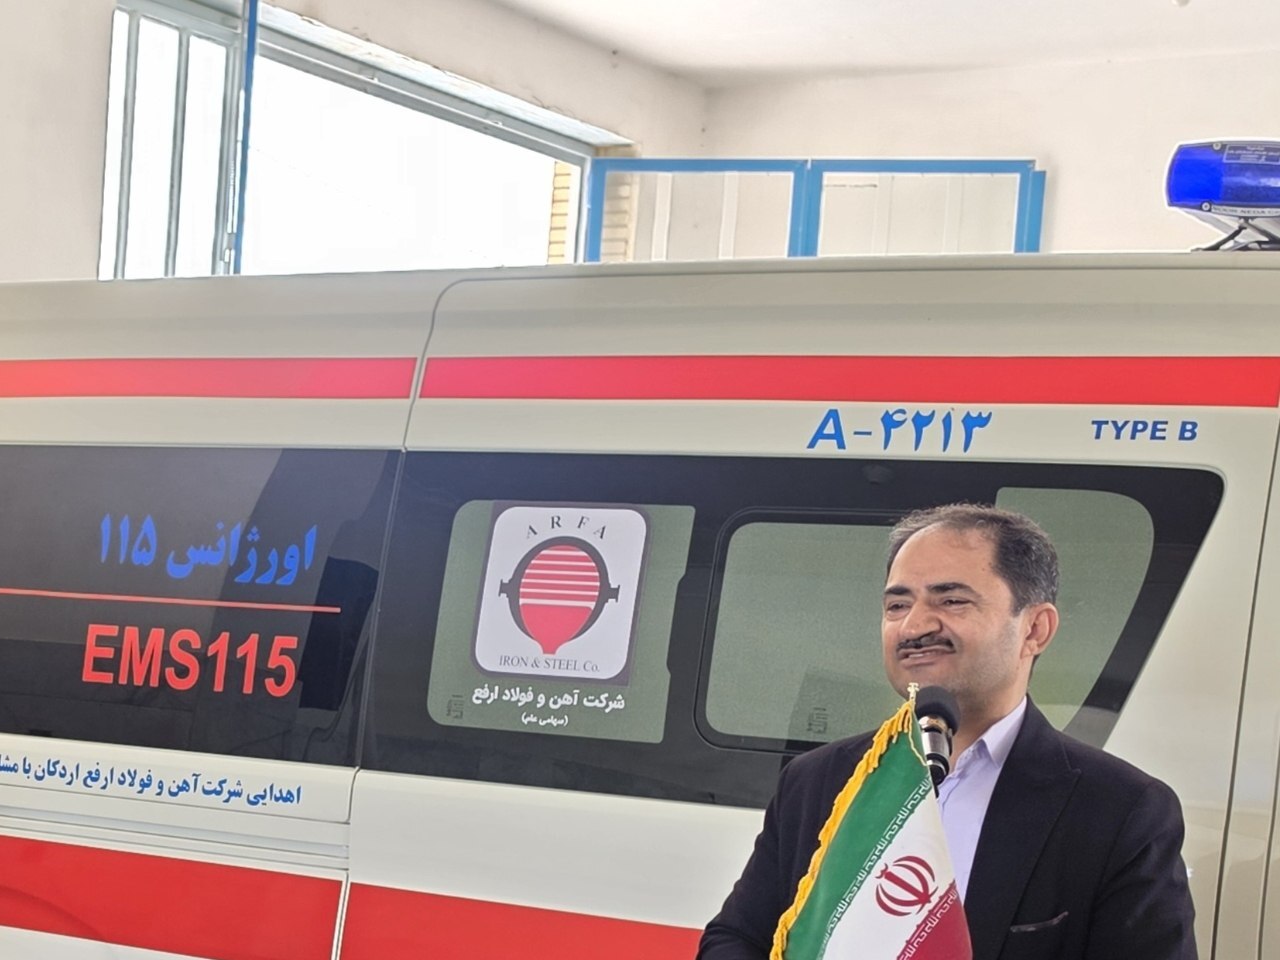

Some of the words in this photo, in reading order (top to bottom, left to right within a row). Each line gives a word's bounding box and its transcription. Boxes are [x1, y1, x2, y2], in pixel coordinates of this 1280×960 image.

[1090, 419, 1168, 441] TYPE
[1178, 420, 1199, 441] B
[100, 513, 157, 566] ۱۱۵
[166, 521, 317, 585] اورژانس
[82, 623, 299, 697] EMS115
[499, 655, 529, 668] IRON
[531, 659, 540, 669] &
[543, 659, 581, 672] STEEL
[583, 661, 601, 673] Co.
[472, 683, 499, 705] ارفع
[502, 686, 534, 707] فولاد
[537, 693, 546, 708] و
[549, 689, 580, 709] آهن
[583, 692, 625, 713] شرکت
[21, 755, 32, 776] با
[33, 758, 79, 785] اردکان
[83, 761, 114, 789] ارفع
[118, 768, 153, 794] فولاد
[156, 780, 164, 797] و
[167, 773, 200, 798] آهن
[201, 779, 243, 804] شرکت
[246, 783, 301, 807] اهدایی
